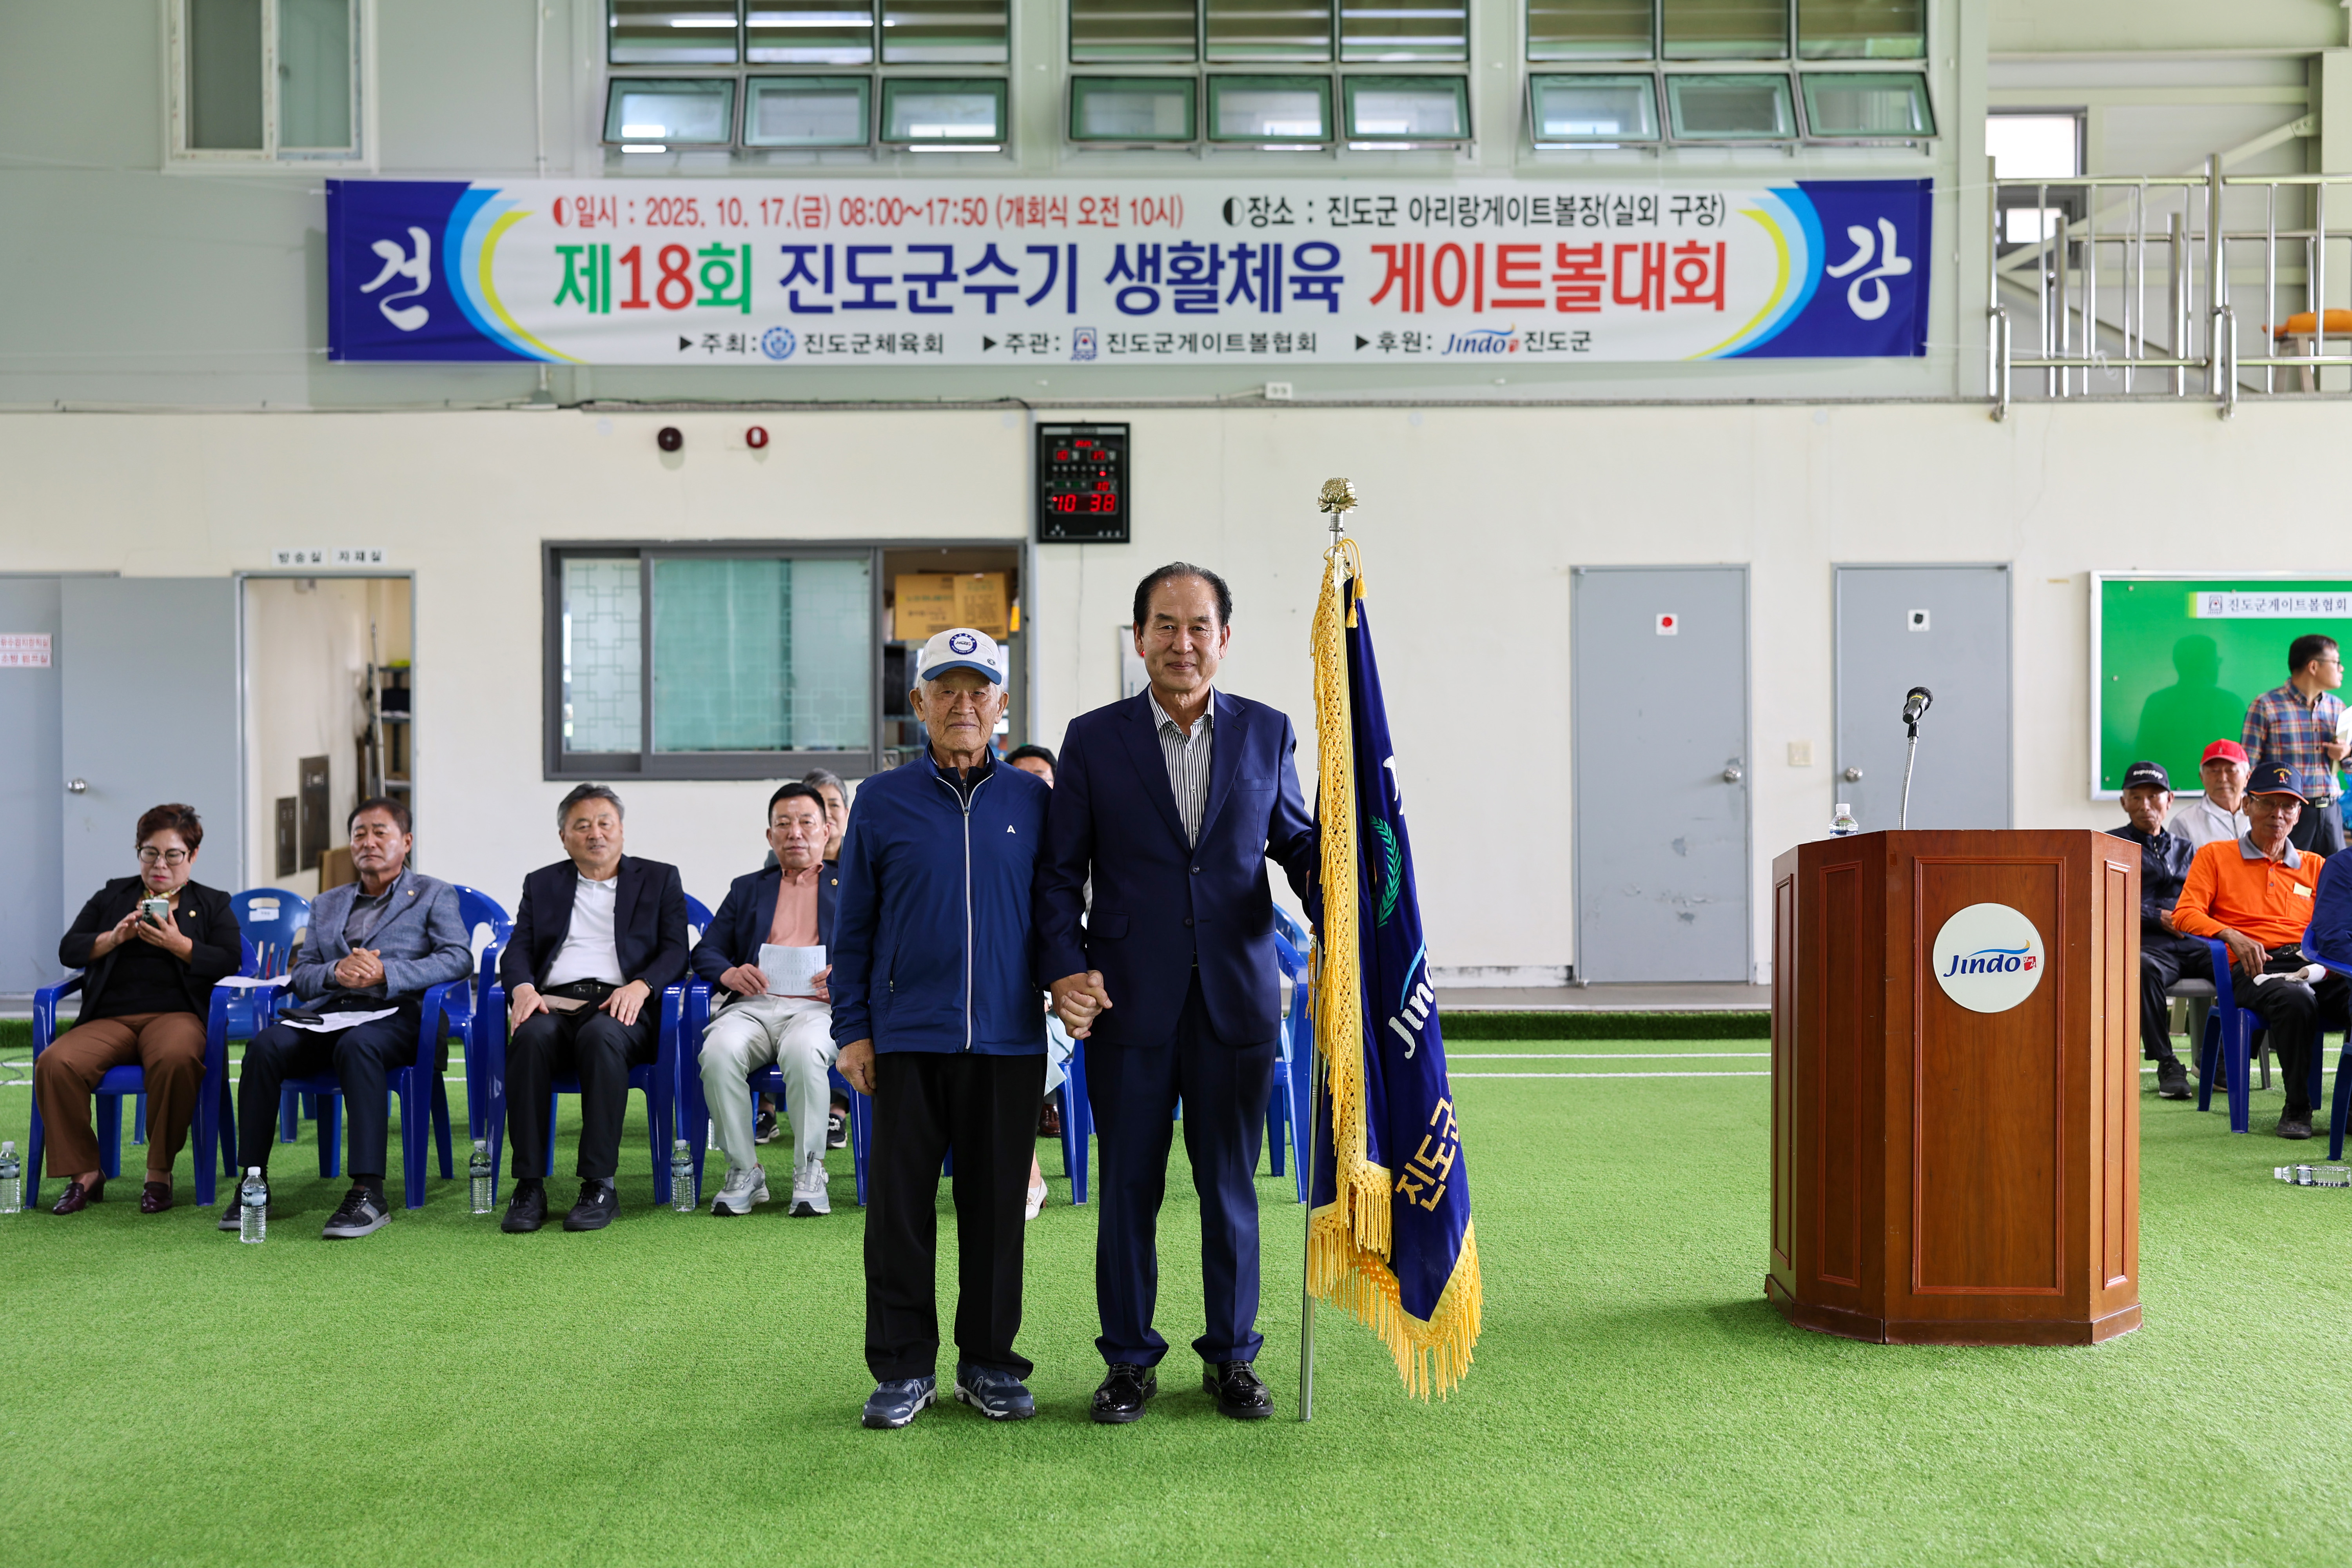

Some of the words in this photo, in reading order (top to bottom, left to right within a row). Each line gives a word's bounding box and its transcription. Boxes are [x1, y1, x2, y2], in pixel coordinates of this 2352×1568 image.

[575, 196, 617, 229] 일시
[645, 196, 706, 228] 2025.
[716, 196, 749, 228] 10.
[839, 196, 988, 227] 08:00~17:50
[996, 194, 1068, 230] (개회식
[1077, 196, 1120, 228] 오전
[1129, 194, 1184, 230] 10시)
[1247, 196, 1295, 229] 장소
[1327, 196, 1398, 227] 진도군
[1410, 193, 1659, 229] 아리랑게이트볼장(실외
[1669, 193, 1726, 227] 구장)
[553, 242, 752, 315] 제18회
[779, 243, 1078, 315] 진도군수기
[1104, 240, 1344, 316] 생활체육
[1369, 240, 1726, 314] 게이트볼대회
[1826, 217, 1912, 321] 강
[701, 333, 757, 354] 주최:
[804, 333, 944, 354] 진도군체육회
[1004, 333, 1060, 354] 주관:
[1107, 332, 1316, 354] 진도군게이트볼협회
[1377, 331, 1432, 354] 후원:
[1441, 334, 1506, 355] Jindo
[1524, 331, 1592, 352] 진도군
[2229, 597, 2347, 612] 진도군게이트볼협회
[1943, 954, 2021, 977] Jindo
[1395, 1070, 1459, 1212] 진도군
